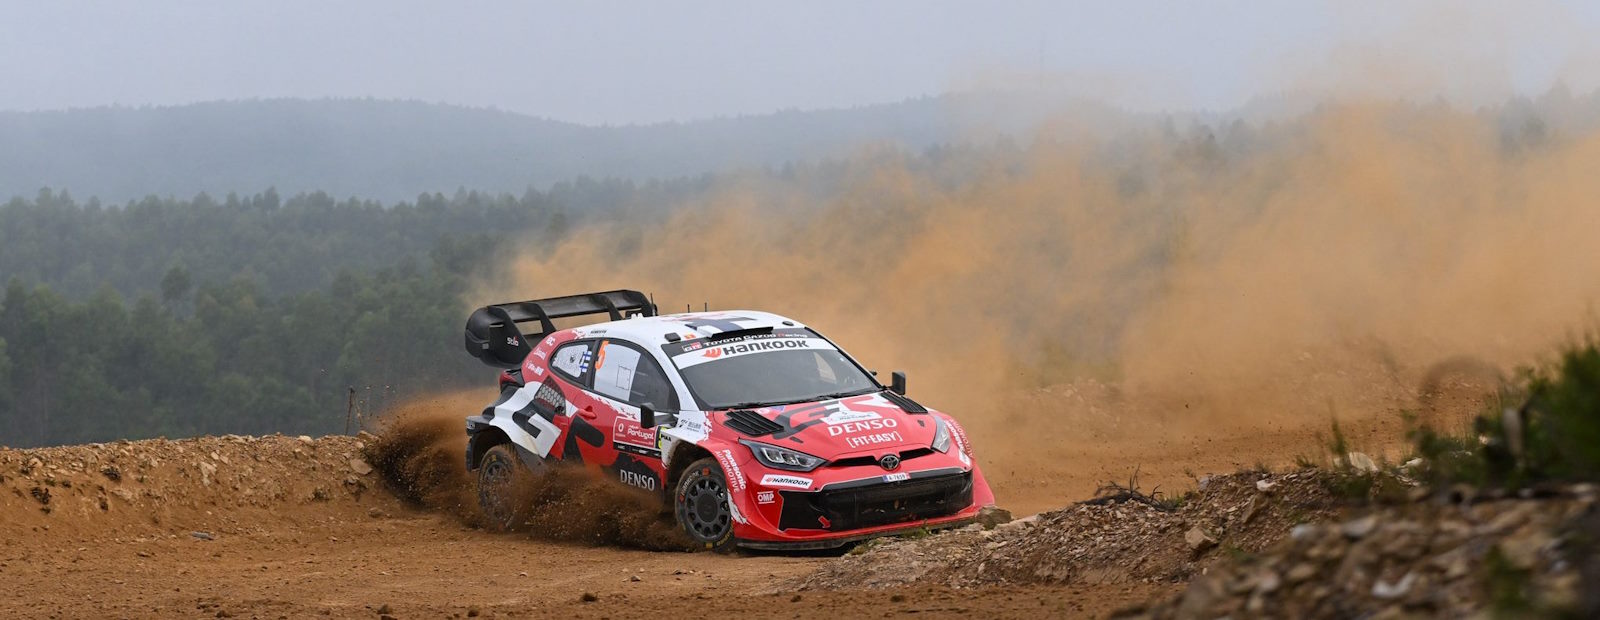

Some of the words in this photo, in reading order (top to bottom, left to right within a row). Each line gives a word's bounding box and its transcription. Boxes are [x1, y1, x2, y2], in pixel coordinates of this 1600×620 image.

[703, 335, 742, 347] TOYOTA
[743, 333, 776, 341] GAZOO
[594, 340, 609, 370] 5
[627, 428, 655, 440] Portugal
[827, 418, 898, 437] DENSO
[715, 450, 740, 492] AUTOMOTIVE
[722, 449, 747, 490] Panasonic
[620, 469, 655, 492] DENSO
[757, 493, 775, 502] OMP
